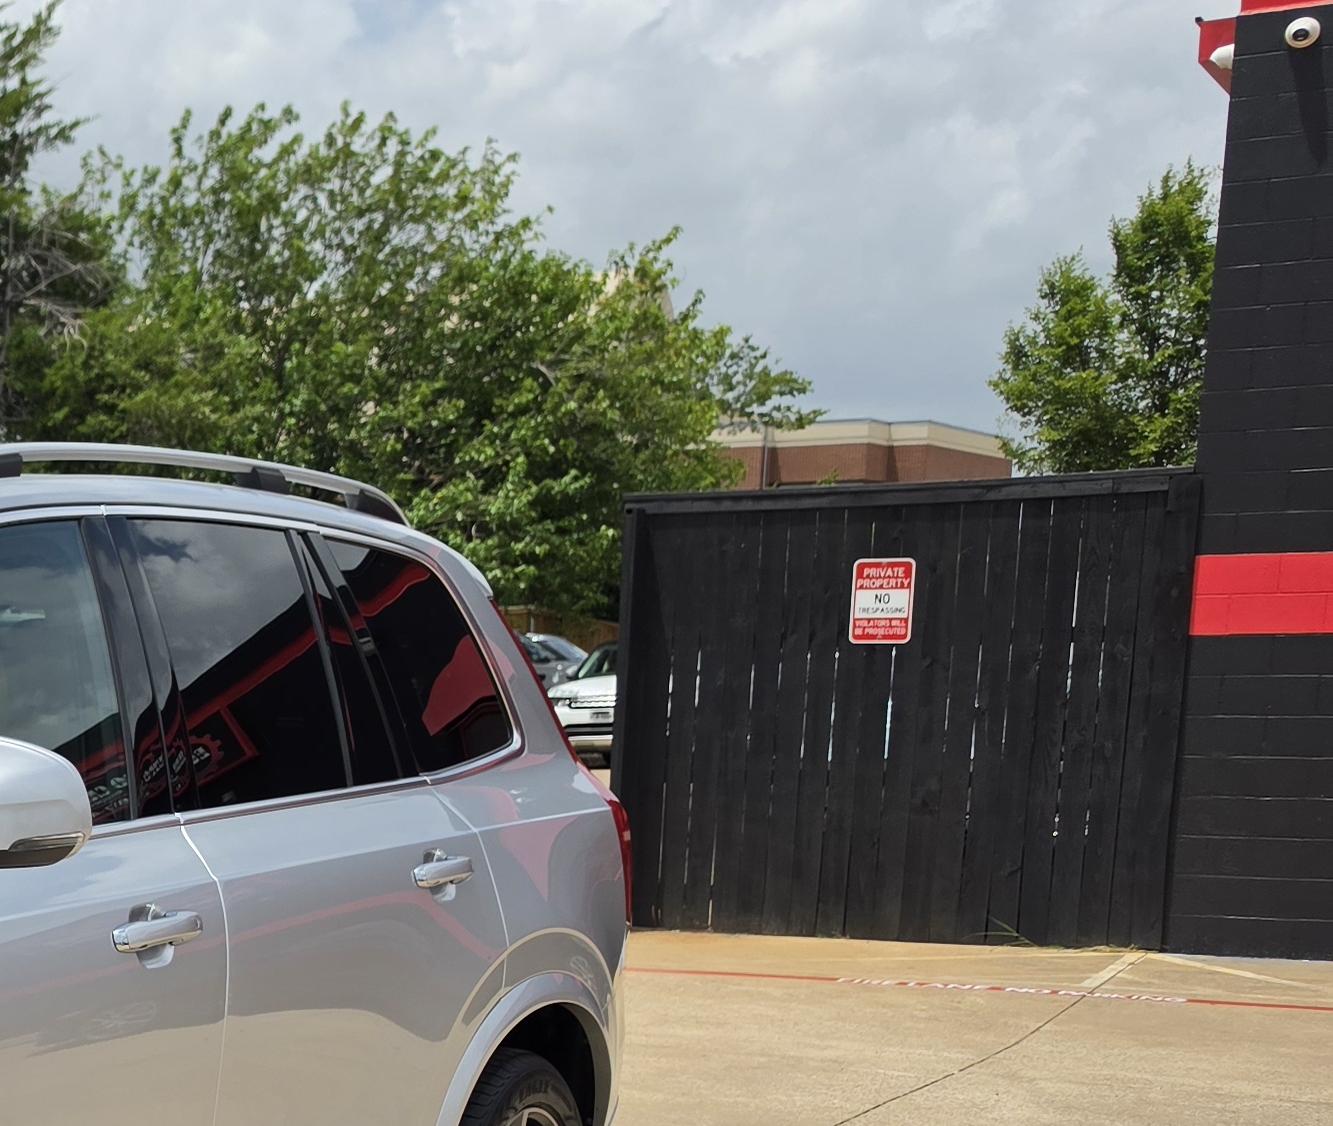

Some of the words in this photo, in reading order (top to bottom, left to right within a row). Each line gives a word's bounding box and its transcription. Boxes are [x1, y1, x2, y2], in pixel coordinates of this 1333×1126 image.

[863, 567, 905, 578] PRIVATE
[856, 578, 910, 588] PROPERTY
[874, 593, 890, 604] NO
[858, 607, 905, 615] TRESPASSING
[864, 627, 906, 636] PROSECUTED
